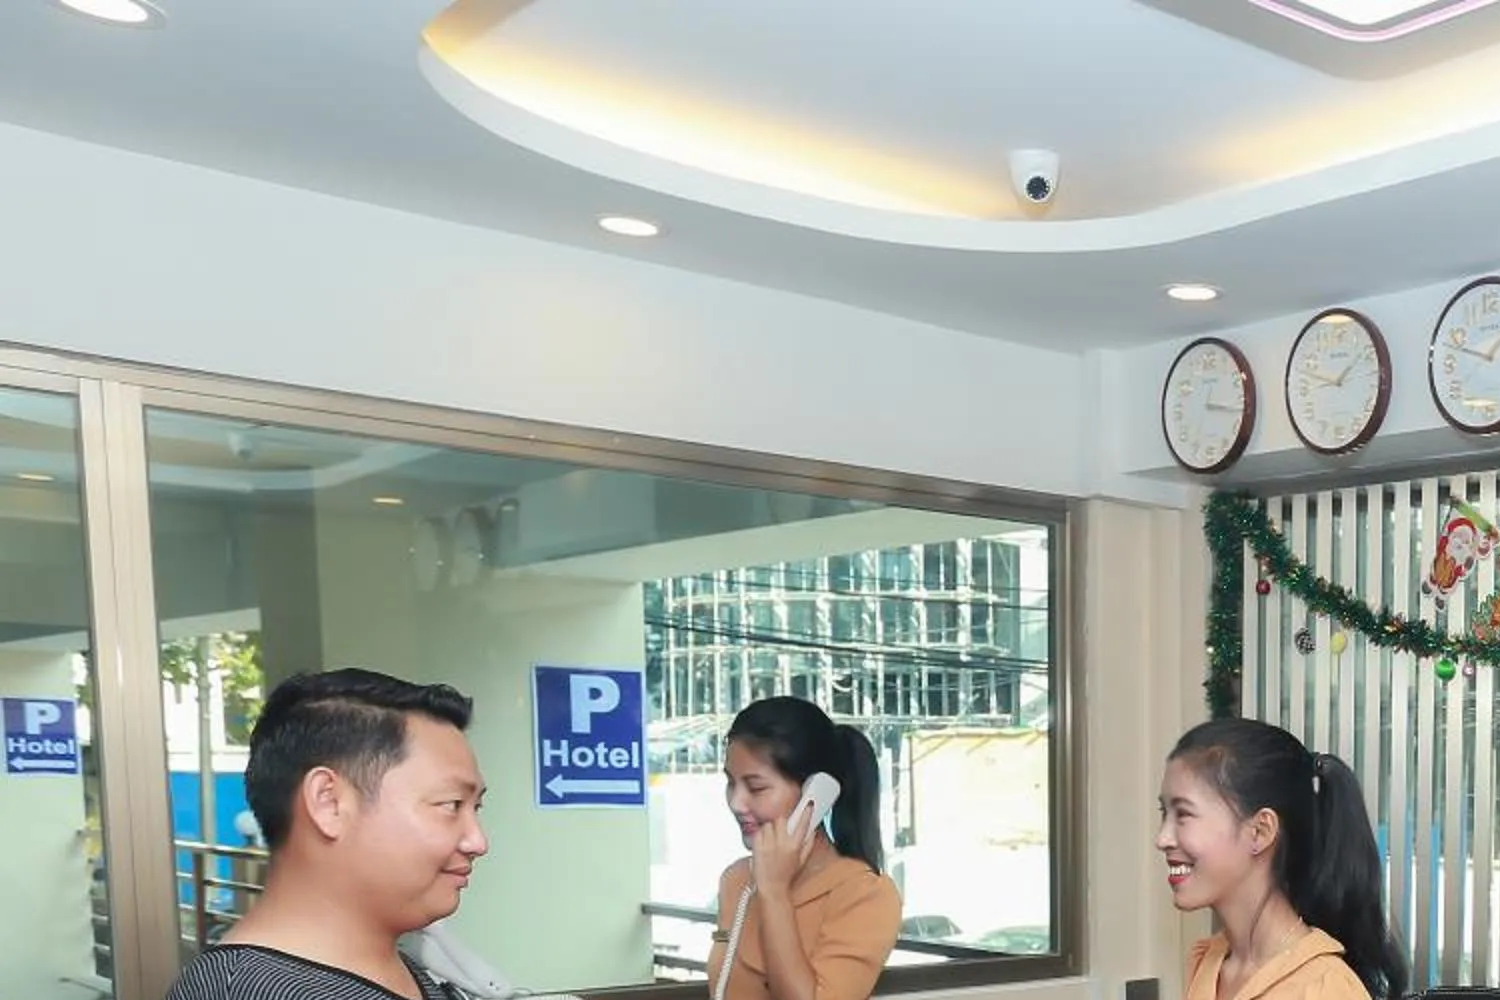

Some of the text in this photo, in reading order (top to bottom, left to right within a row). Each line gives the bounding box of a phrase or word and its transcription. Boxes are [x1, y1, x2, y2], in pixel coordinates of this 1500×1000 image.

[25, 702, 61, 735] P
[569, 673, 621, 734] P
[8, 737, 75, 755] Hotel
[543, 739, 640, 769] Hotel
